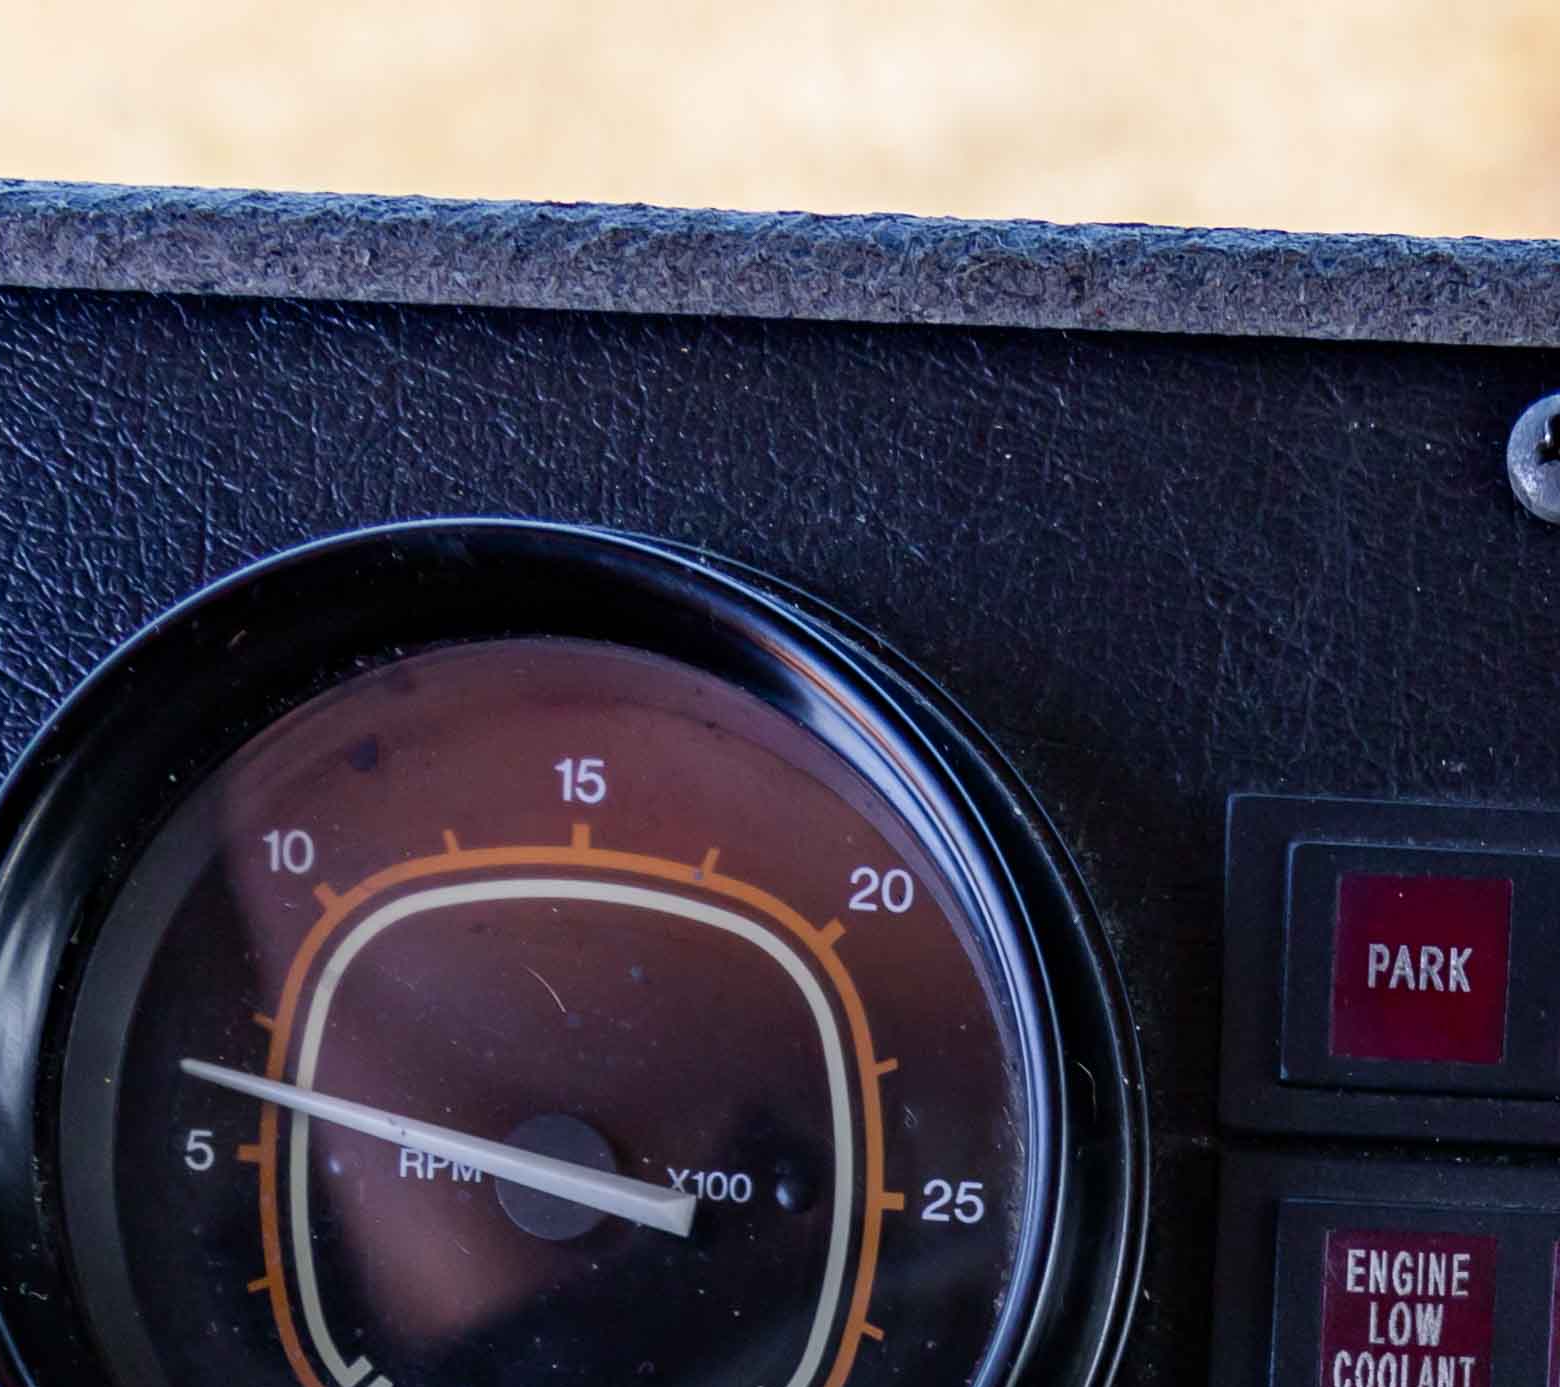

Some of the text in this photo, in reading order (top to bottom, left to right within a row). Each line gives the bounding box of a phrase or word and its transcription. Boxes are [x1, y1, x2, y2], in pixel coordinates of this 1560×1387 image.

[555, 759, 608, 804] 15
[262, 829, 315, 875] 10
[848, 866, 915, 914] 20
[1366, 942, 1474, 994] PARK
[184, 1130, 215, 1172] 5
[399, 1148, 483, 1184] RPM
[921, 1179, 986, 1226] 25
[1345, 1248, 1472, 1298] ENGINE
[1368, 1300, 1445, 1347] LOW
